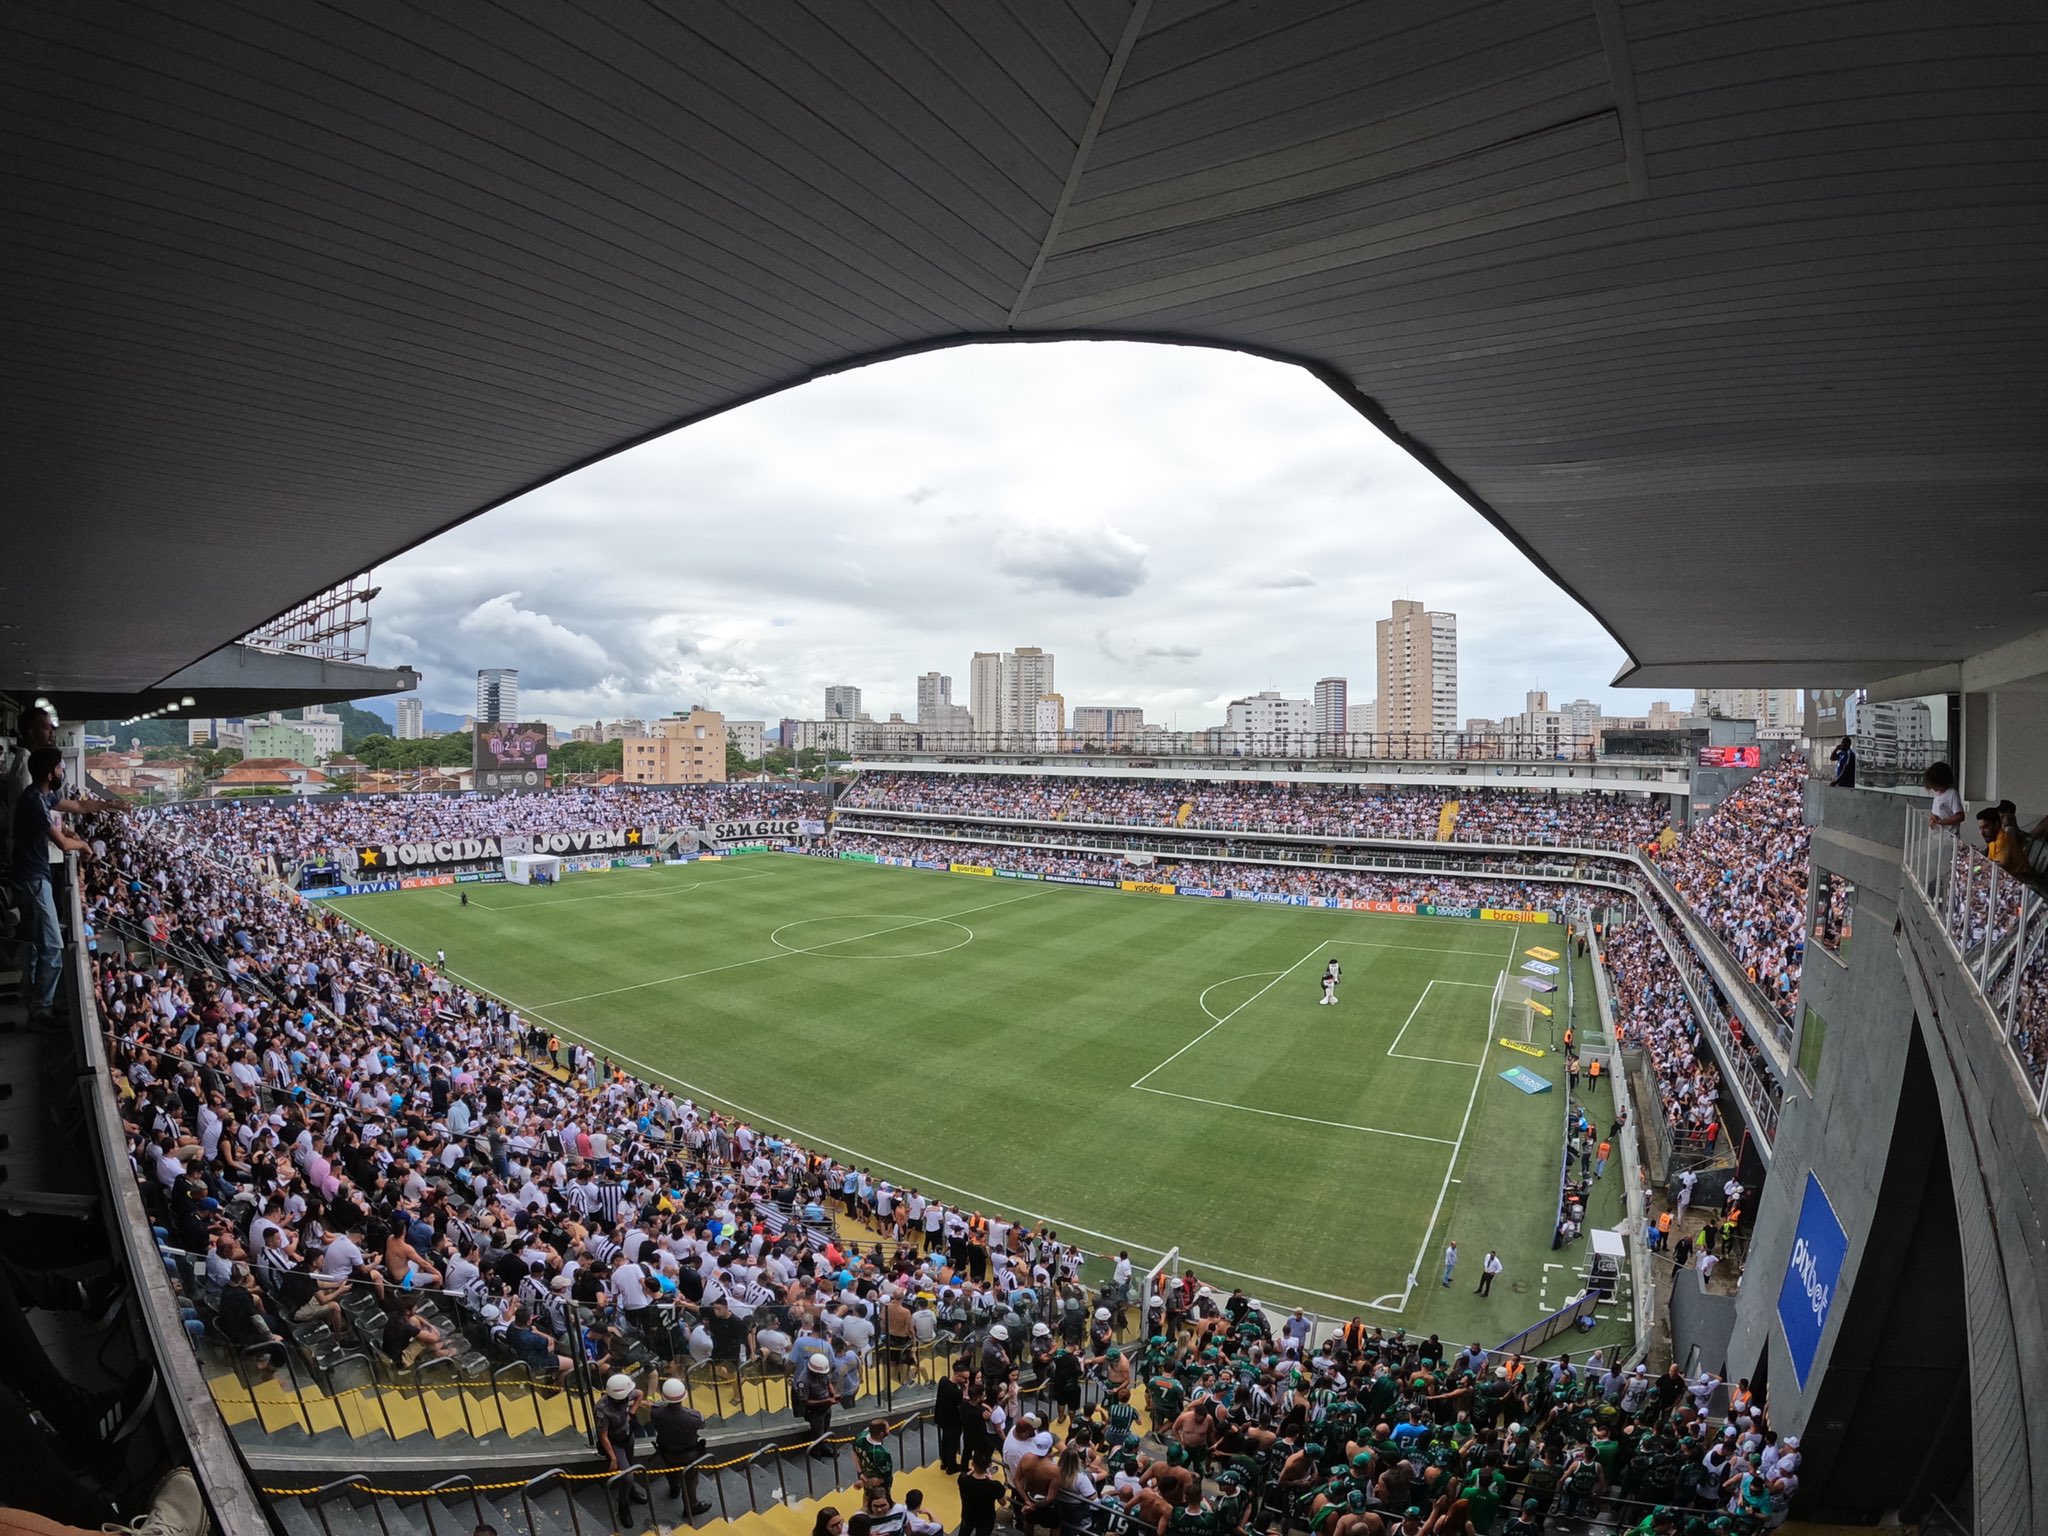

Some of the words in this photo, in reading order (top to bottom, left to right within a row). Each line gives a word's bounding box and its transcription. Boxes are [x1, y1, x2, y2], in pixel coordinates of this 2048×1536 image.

[381, 838, 501, 866] TORCIDA
[534, 829, 627, 853] JOVEM
[569, 863, 579, 872] Sil
[591, 861, 601, 869] Sil
[957, 865, 986, 874] quartzolit
[351, 881, 398, 894] HAVAN
[402, 879, 417, 889] GOL
[420, 878, 435, 887] GOL
[438, 876, 453, 885] GOL
[1134, 884, 1162, 893] vonder
[1180, 886, 1226, 897] sportingbet
[1296, 896, 1308, 905] Sil
[1324, 897, 1337, 908] Sil
[1354, 900, 1370, 910] GOL
[1375, 902, 1392, 911] GOL
[1397, 904, 1414, 913] GOL
[1493, 910, 1535, 922] brasilit
[1791, 1237, 1830, 1328] pixbet
